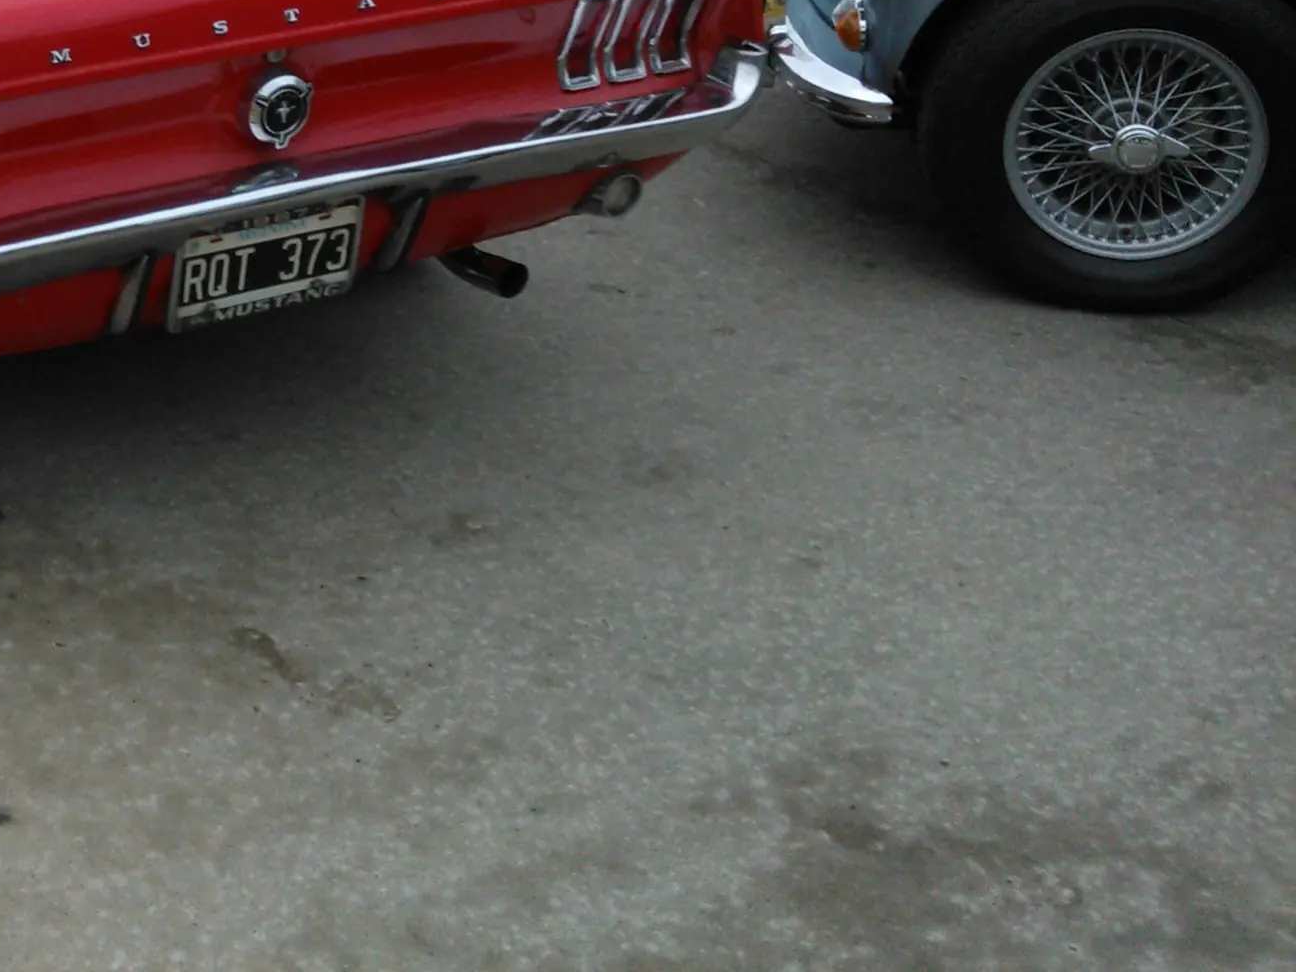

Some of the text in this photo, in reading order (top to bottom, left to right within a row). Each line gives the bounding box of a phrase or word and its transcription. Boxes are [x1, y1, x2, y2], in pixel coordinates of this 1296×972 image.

[183, 247, 257, 305] RQT
[278, 227, 350, 282] 373
[213, 282, 341, 321] MUSTANG
